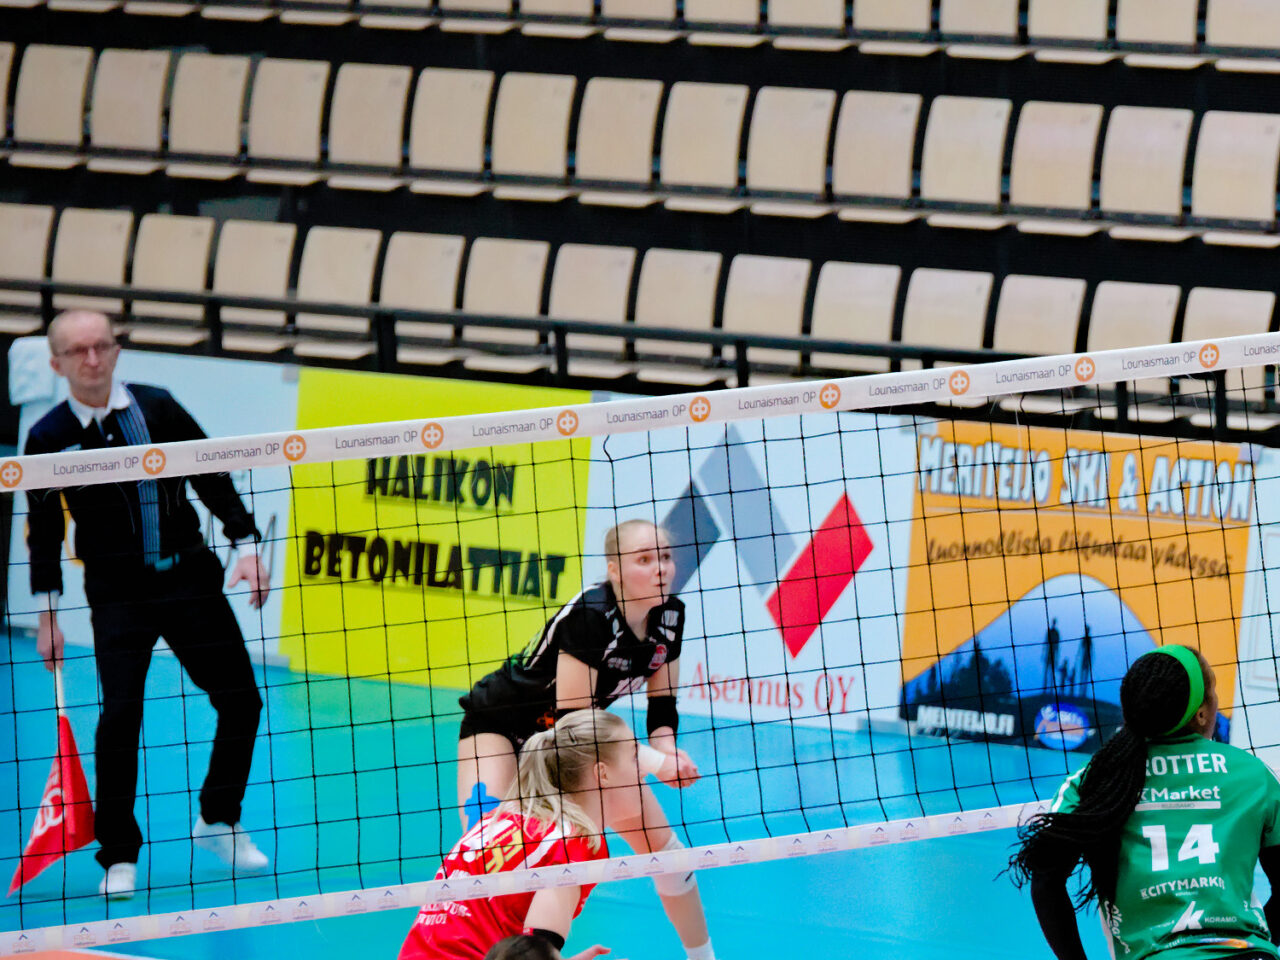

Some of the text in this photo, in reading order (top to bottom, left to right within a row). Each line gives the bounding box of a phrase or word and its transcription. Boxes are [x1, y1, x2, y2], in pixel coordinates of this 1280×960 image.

[1122, 356, 1181, 369] Lounaismaan
[997, 370, 1055, 383] Lounaismaan
[870, 383, 928, 395] Lounaismaan
[739, 397, 799, 409] Lounaismaan
[608, 410, 669, 423] Lounaismaan
[473, 423, 536, 436] Lounaismaan
[336, 436, 399, 448] Lounaismaan
[197, 448, 262, 461] Lounaismaan
[54, 462, 120, 474] Lounaismaan
[366, 454, 516, 509] HALIKON
[1148, 456, 1255, 521] ACTION
[304, 530, 567, 599] BETONILATTIAT
[1142, 824, 1220, 871] 14
